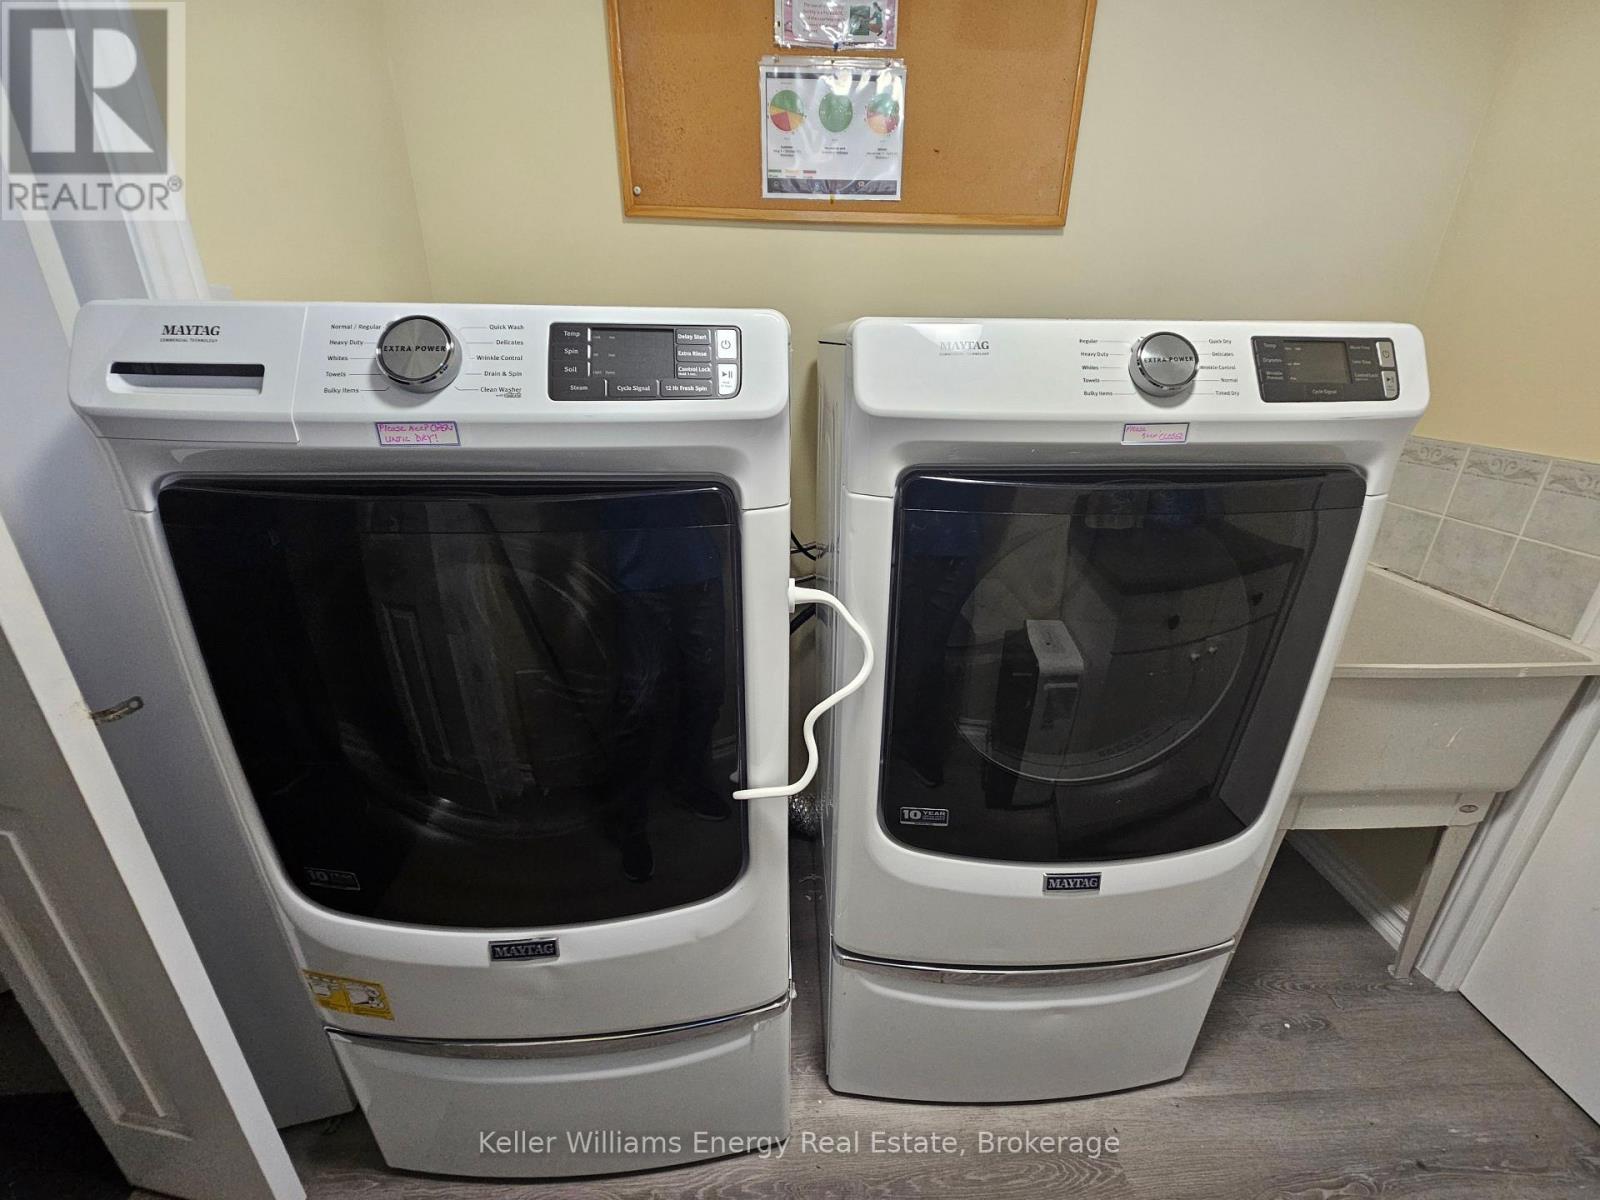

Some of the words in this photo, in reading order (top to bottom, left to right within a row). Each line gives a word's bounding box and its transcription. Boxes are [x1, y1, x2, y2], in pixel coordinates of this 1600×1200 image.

[161, 325, 221, 336] MAYTAG
[358, 324, 382, 332] Regular
[563, 330, 580, 338] Temp
[677, 333, 693, 341] Delay
[329, 339, 348, 347] Heavy
[349, 339, 364, 347] Duty
[940, 341, 990, 350] MAYTAG
[563, 348, 579, 356] Spin
[323, 387, 341, 395] Bulky
[903, 809, 922, 820] 10
[1047, 877, 1098, 889] MAYTAG
[494, 943, 555, 959] MAYTAG
